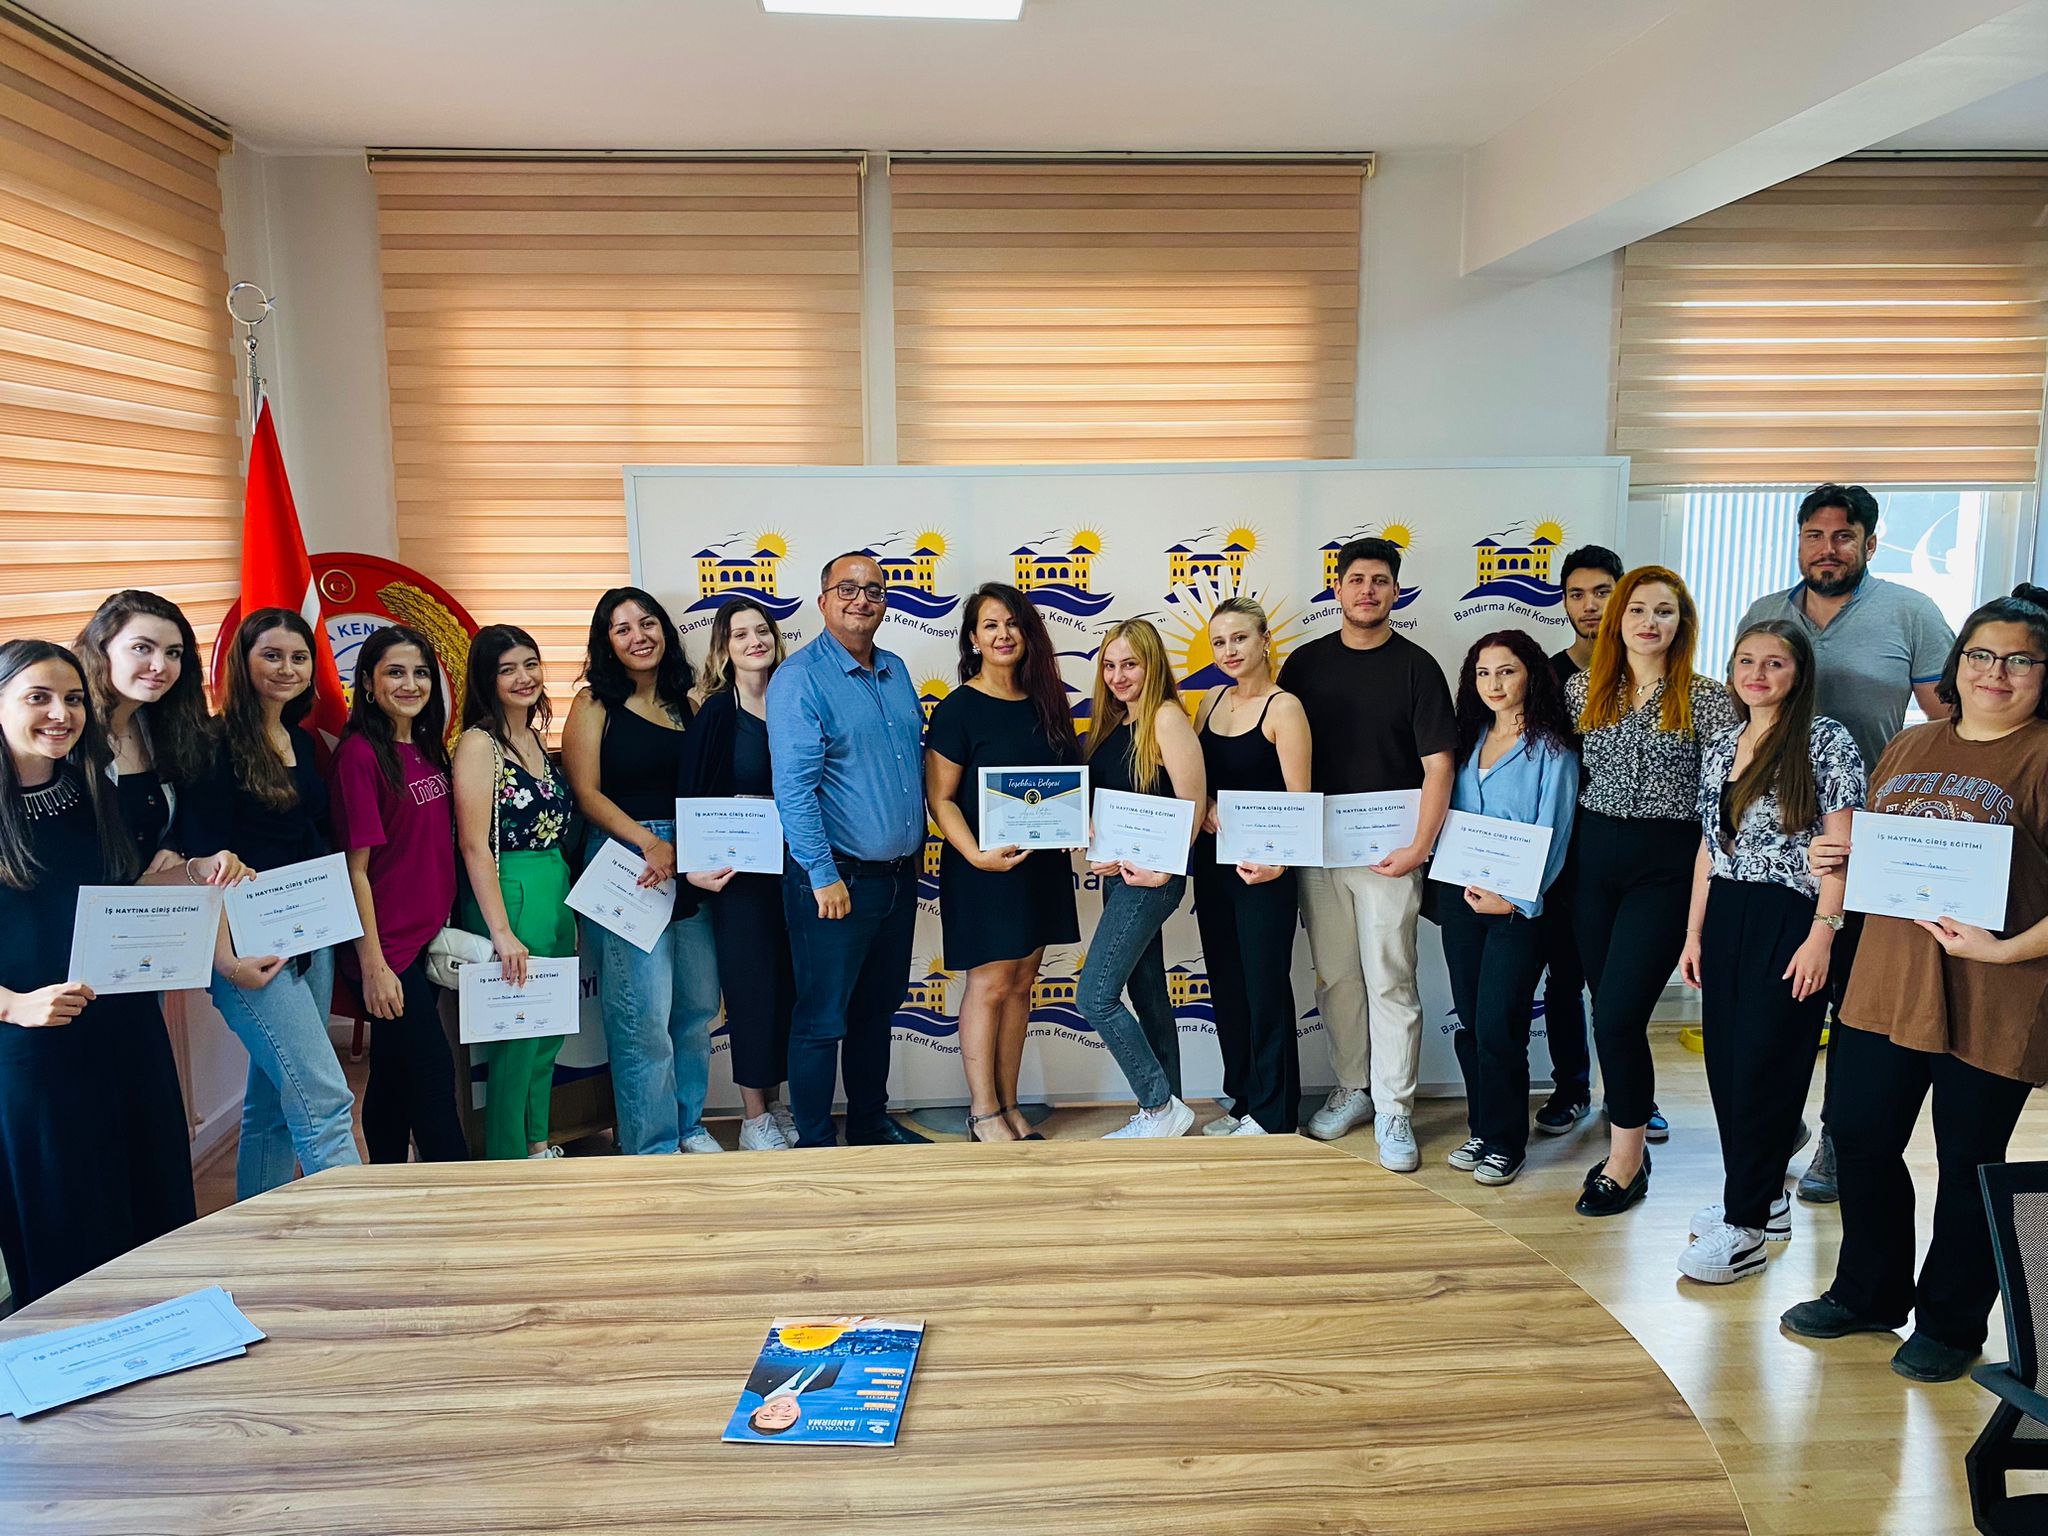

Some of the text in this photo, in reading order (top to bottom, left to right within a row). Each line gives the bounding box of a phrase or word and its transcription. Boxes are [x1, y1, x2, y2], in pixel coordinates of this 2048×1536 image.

[1049, 612, 1073, 626] Kent
[1302, 607, 1418, 630] Bandırm onseyi
[1454, 602, 1569, 627] Bandırma Kent Konseyi
[337, 622, 376, 638] KEN
[679, 616, 802, 641] Bandır seyi
[894, 614, 918, 628] Kent
[920, 622, 959, 638] Konseyi
[1038, 778, 1061, 788] Belgesi
[1939, 773, 2014, 824] CAMPUS
[1886, 804, 1900, 812] EST
[1887, 834, 1922, 844] HAYTINA
[1925, 838, 1948, 846] GİRİŞ
[1950, 840, 1982, 850] EĞİTİMİ
[254, 886, 284, 897] HAYTINA
[285, 881, 303, 890] GİRİŞ
[304, 874, 328, 884] EĞİTİMİ
[151, 906, 170, 914] GİRİŞ
[1054, 1028, 1077, 1041] Kent
[1078, 1035, 1106, 1048] Konse
[1296, 1023, 1324, 1038] Bandı
[906, 1032, 930, 1046] Kent
[808, 1418, 856, 1426] BANDIRMA
